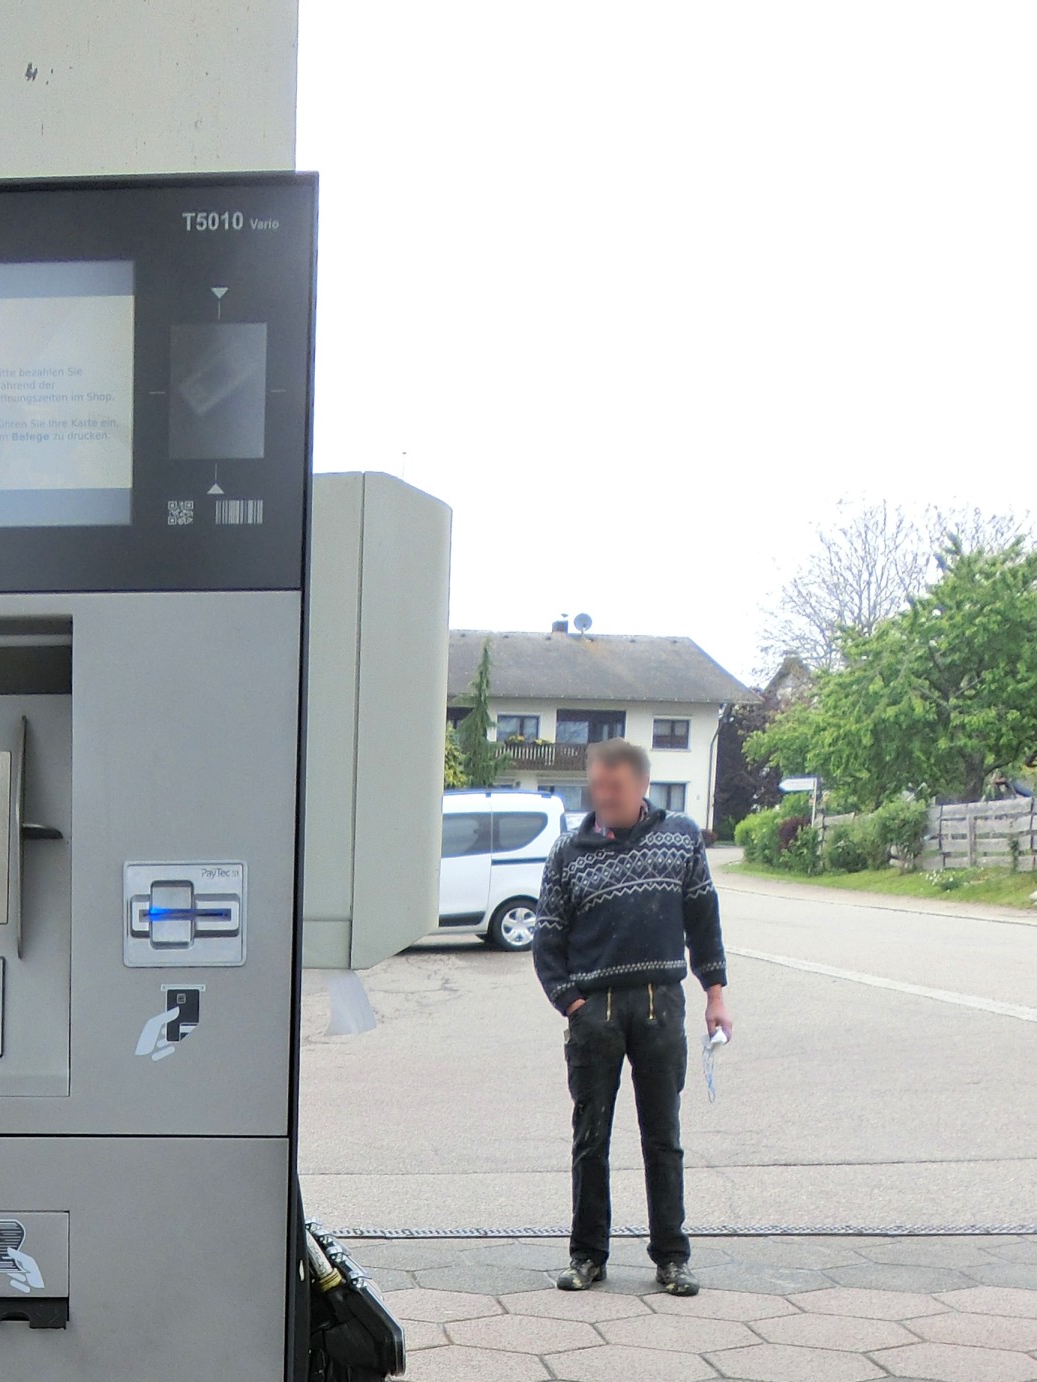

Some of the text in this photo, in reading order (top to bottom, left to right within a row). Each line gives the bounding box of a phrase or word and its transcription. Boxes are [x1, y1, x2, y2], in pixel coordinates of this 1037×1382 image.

[182, 211, 279, 231] T5010 Vario
[19, 367, 64, 377] bezahlen
[67, 367, 83, 377] Sie
[38, 380, 56, 390] der
[71, 391, 84, 402] im
[86, 392, 115, 404] Shop.
[30, 418, 45, 428] Sie
[71, 418, 98, 428] Karte
[12, 431, 50, 443] Belege
[53, 433, 64, 441] zu
